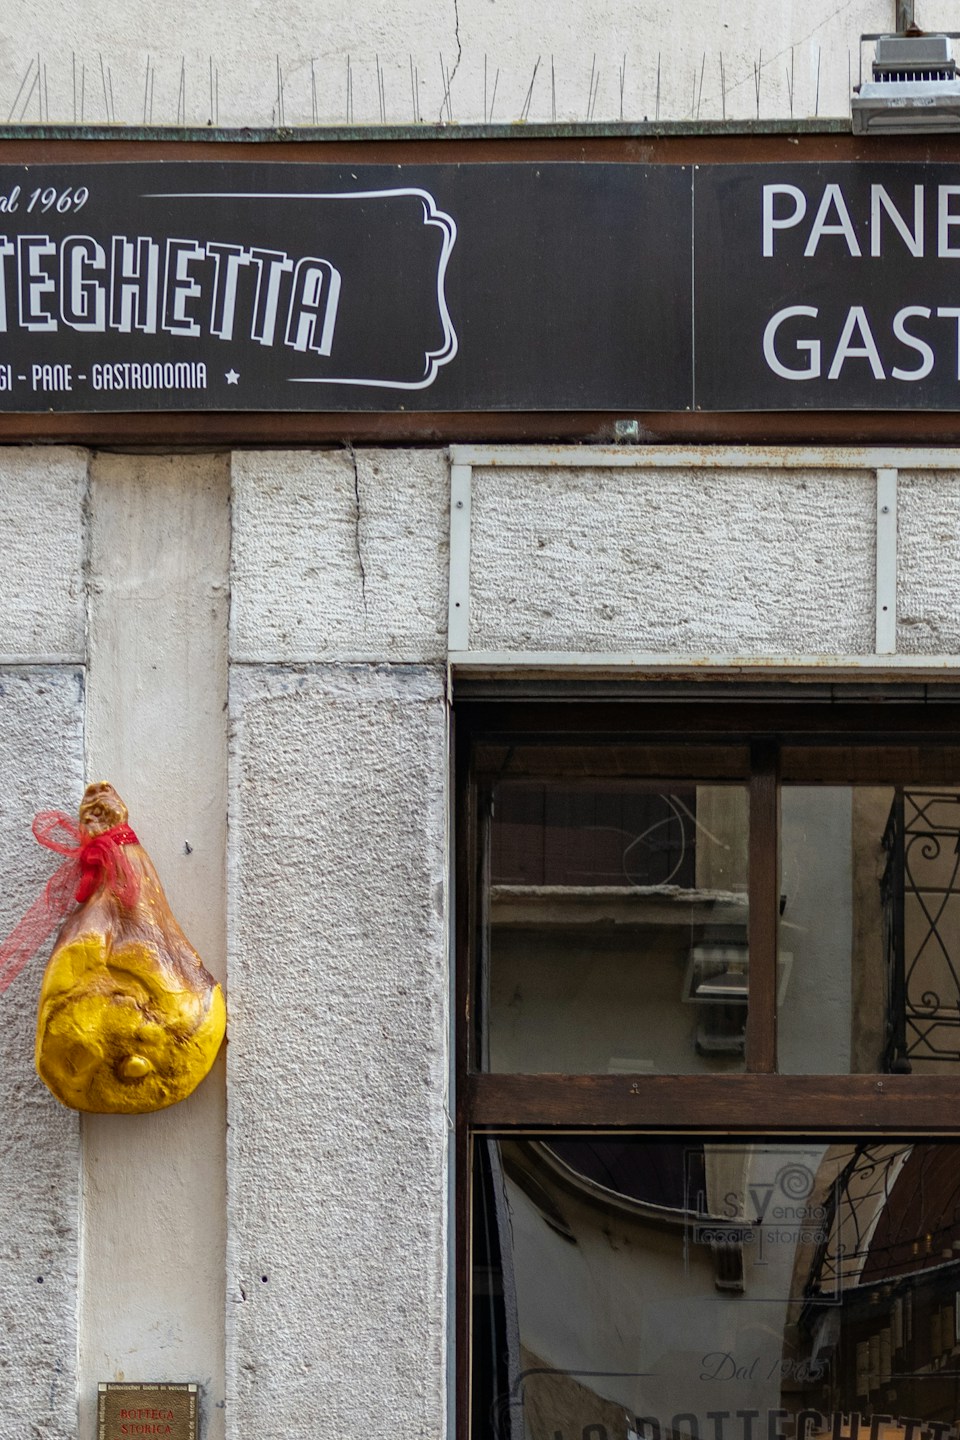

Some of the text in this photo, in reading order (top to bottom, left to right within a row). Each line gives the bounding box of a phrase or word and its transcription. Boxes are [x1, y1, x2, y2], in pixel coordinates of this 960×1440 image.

[27, 186, 89, 213] 1969
[32, 364, 72, 391] PANE
[92, 361, 207, 391] GASTRONOMIA
[699, 1351, 760, 1380] Dal
[120, 1409, 174, 1419] BOTTEGA
[121, 1424, 172, 1435] STORICA
